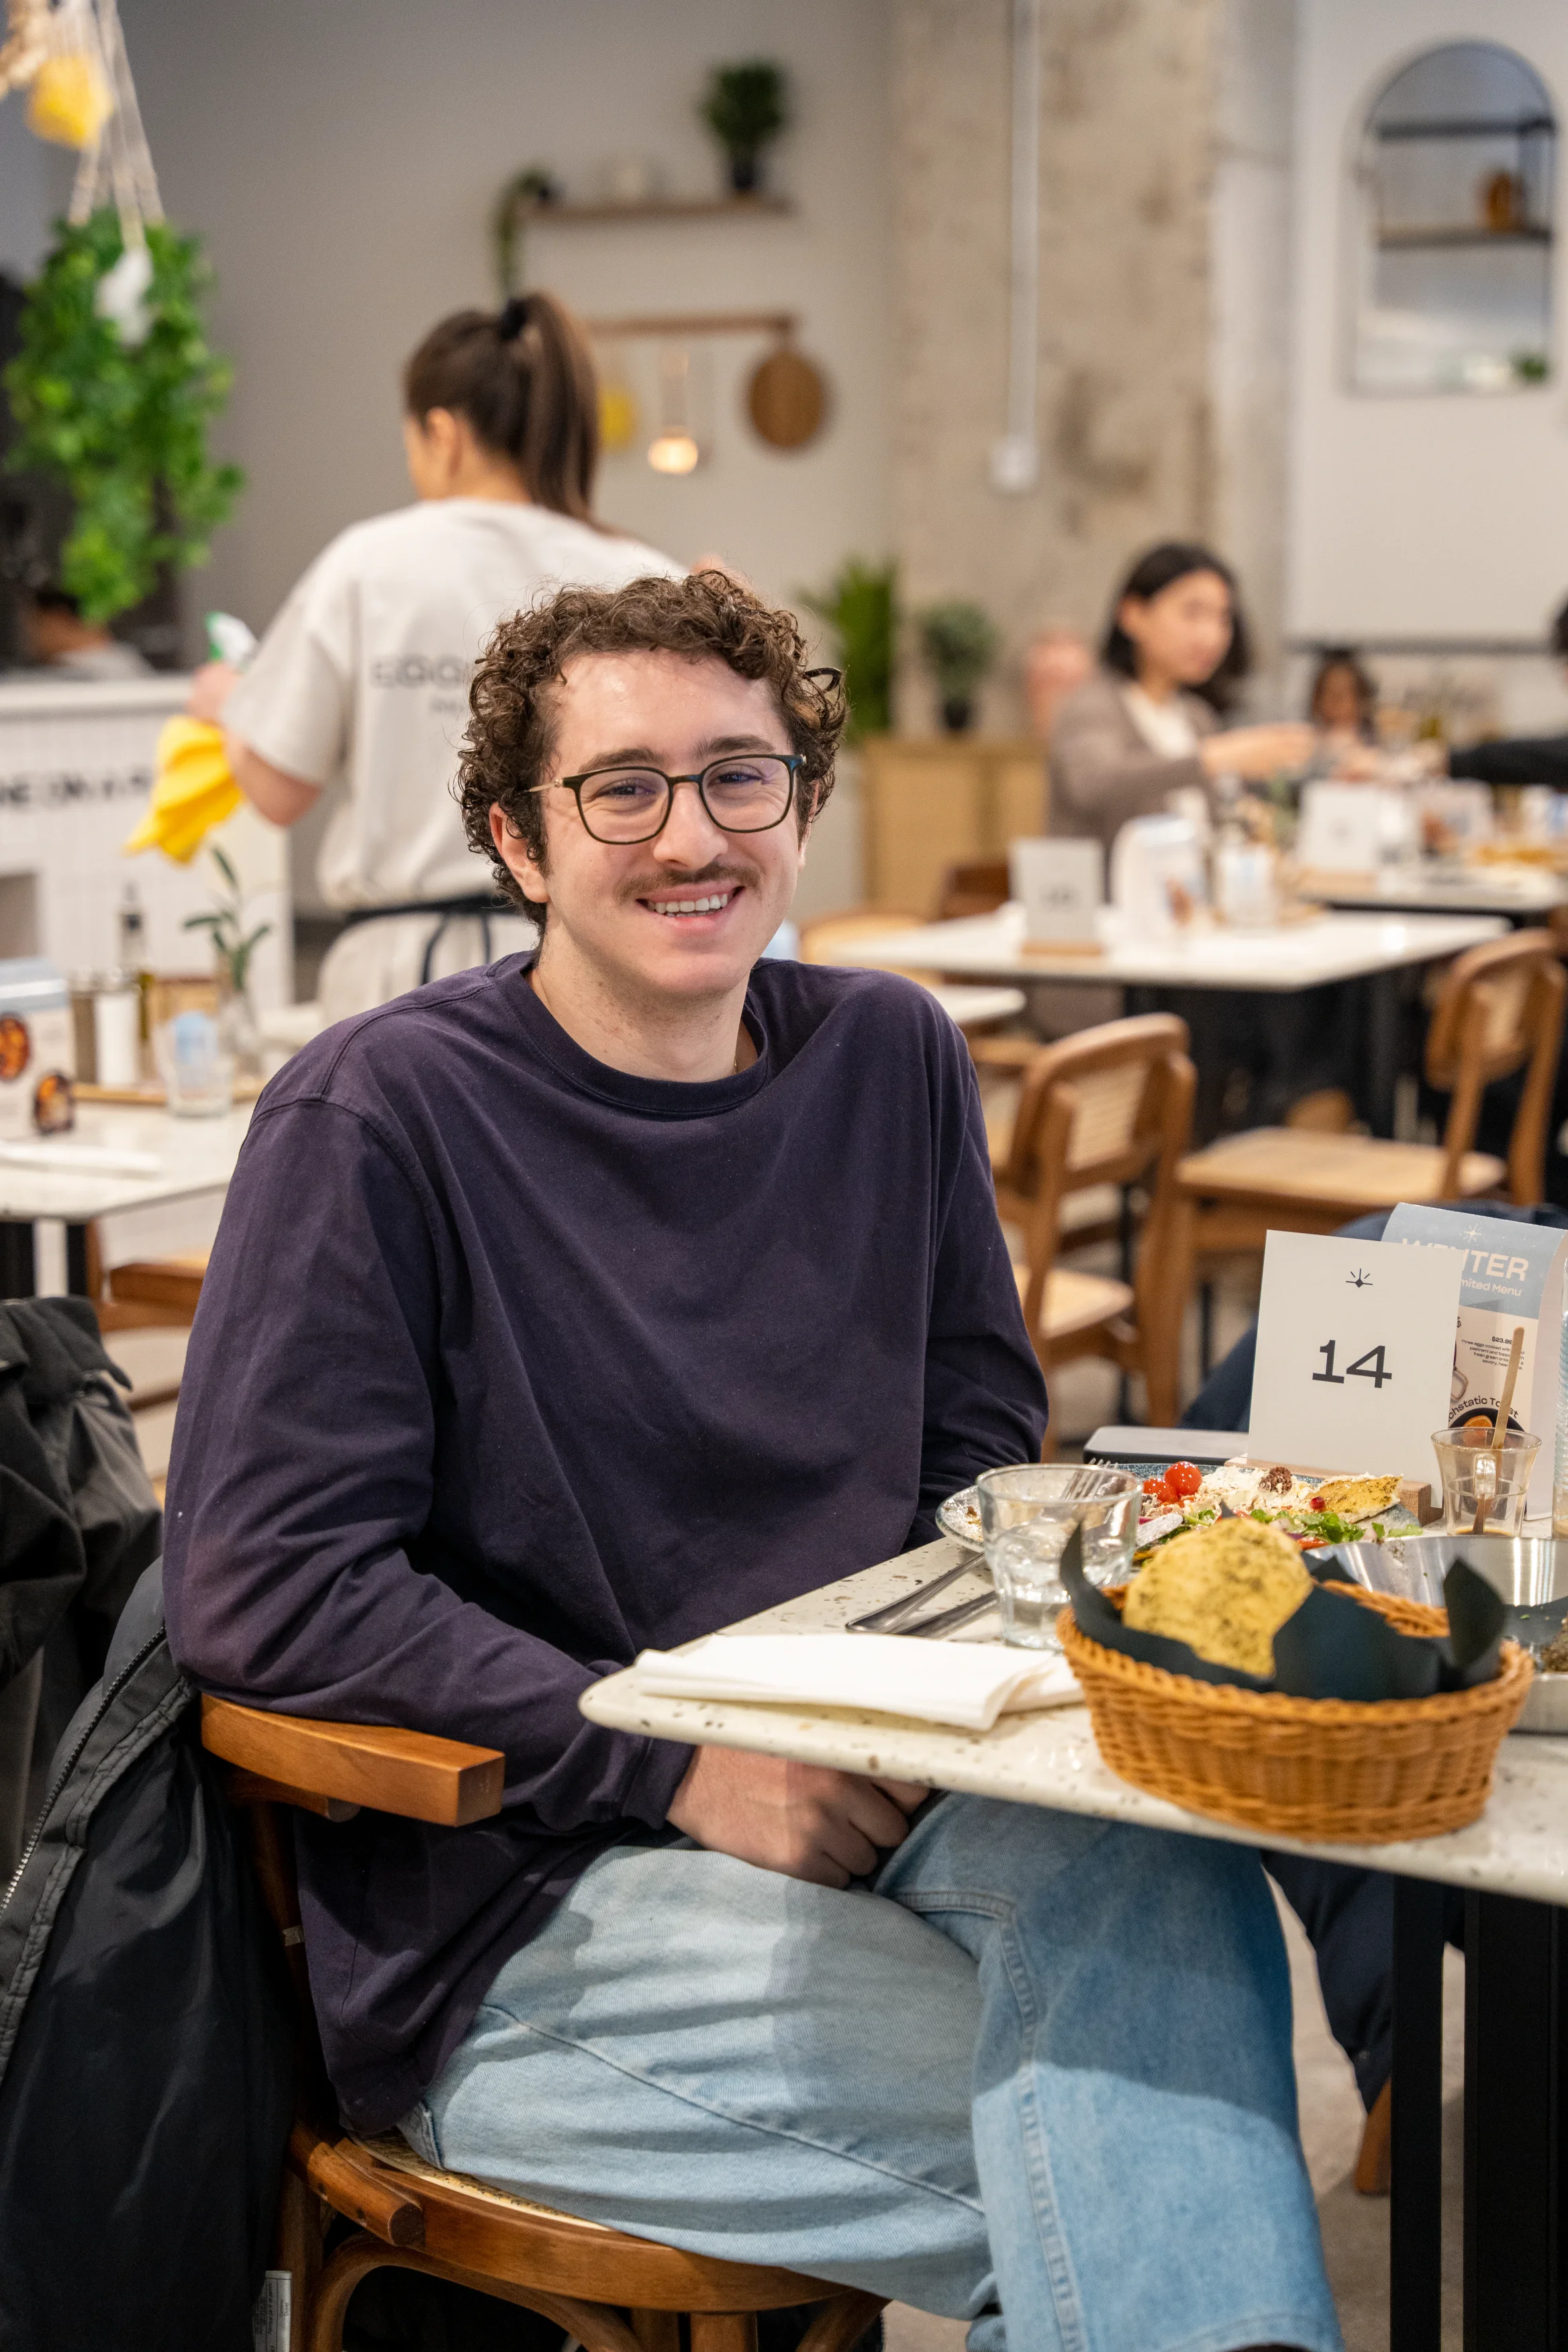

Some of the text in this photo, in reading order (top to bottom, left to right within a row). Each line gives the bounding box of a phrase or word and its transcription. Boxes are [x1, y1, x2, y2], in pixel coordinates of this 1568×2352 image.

[1402, 1238, 1529, 1281] TER
[1461, 1277, 1522, 1296] mited Menu
[1312, 1340, 1392, 1388] 14
[1449, 1395, 1518, 1422] chstatic Tost
